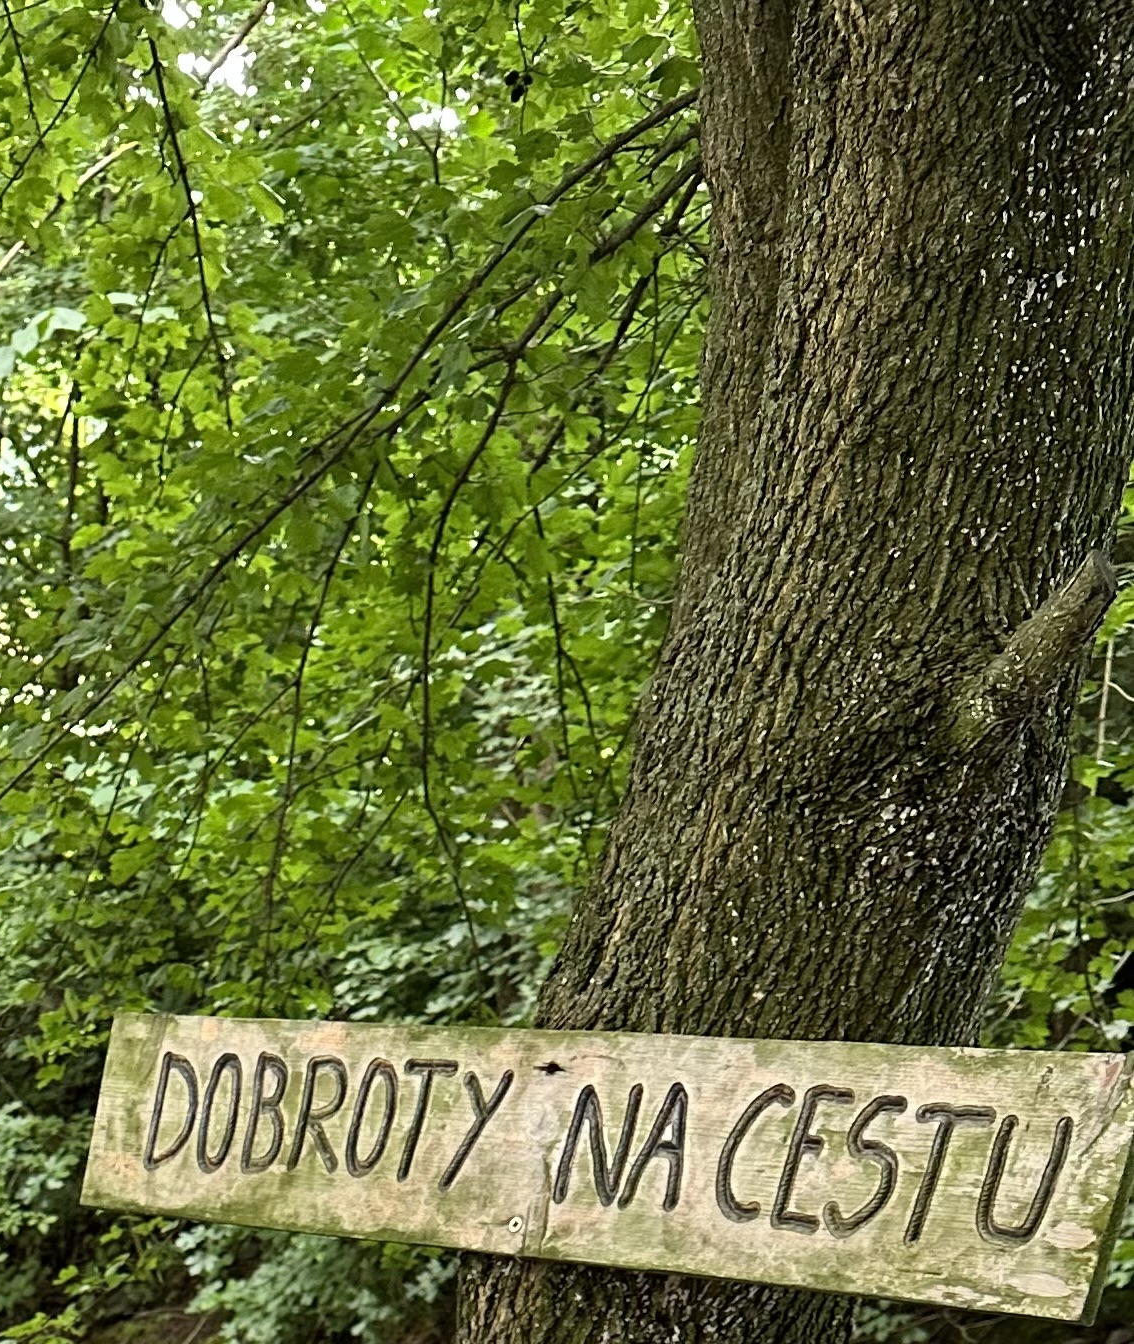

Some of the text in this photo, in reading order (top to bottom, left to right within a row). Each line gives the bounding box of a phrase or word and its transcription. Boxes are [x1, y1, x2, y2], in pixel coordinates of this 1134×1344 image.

[142, 1050, 1074, 1247] DOBROTY NA CESTU
